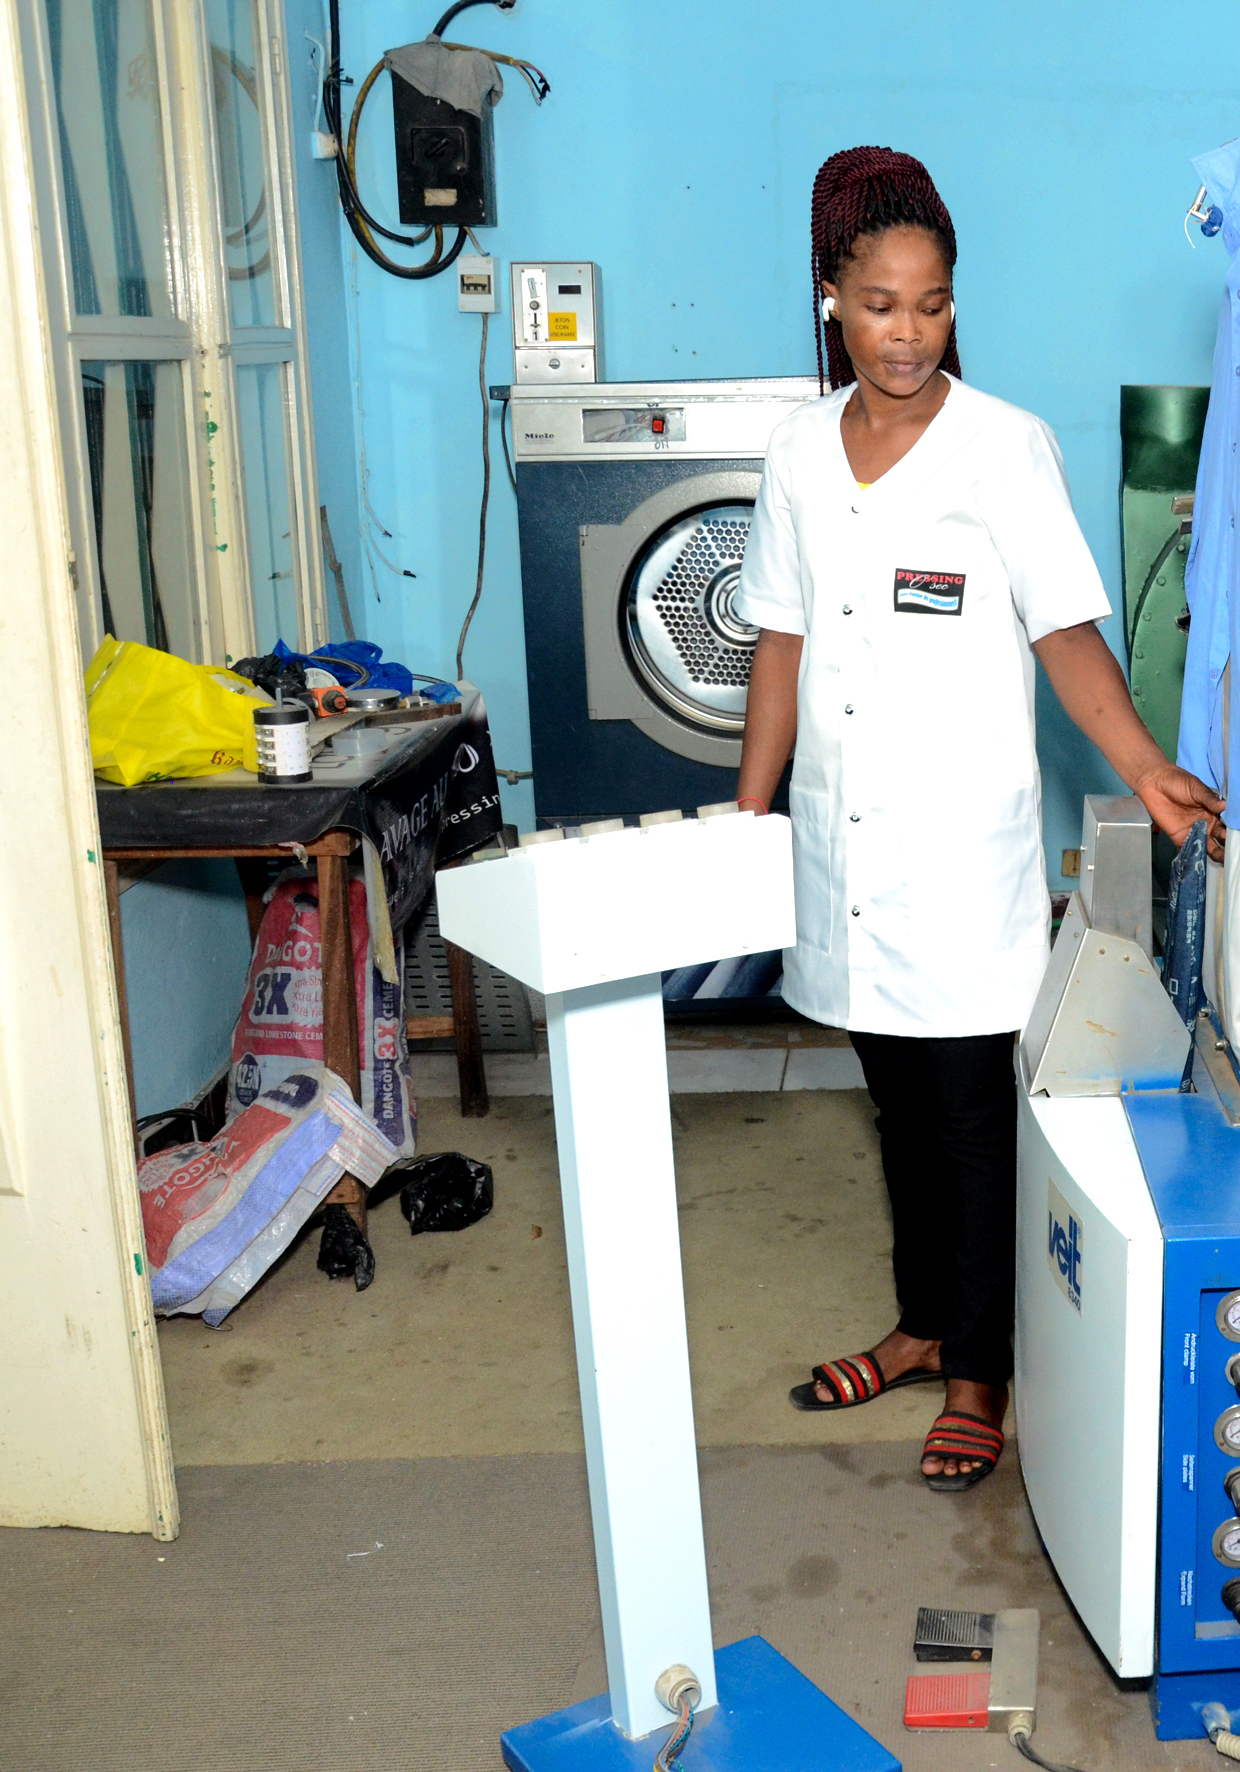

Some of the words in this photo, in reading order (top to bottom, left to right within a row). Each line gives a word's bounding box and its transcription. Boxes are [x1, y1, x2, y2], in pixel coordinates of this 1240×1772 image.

[524, 432, 555, 440] Miele
[896, 571, 963, 584] PRESSING
[253, 972, 292, 1016] 3X
[382, 1061, 394, 1119] DANGOTE
[1048, 1210, 1081, 1298] veit
